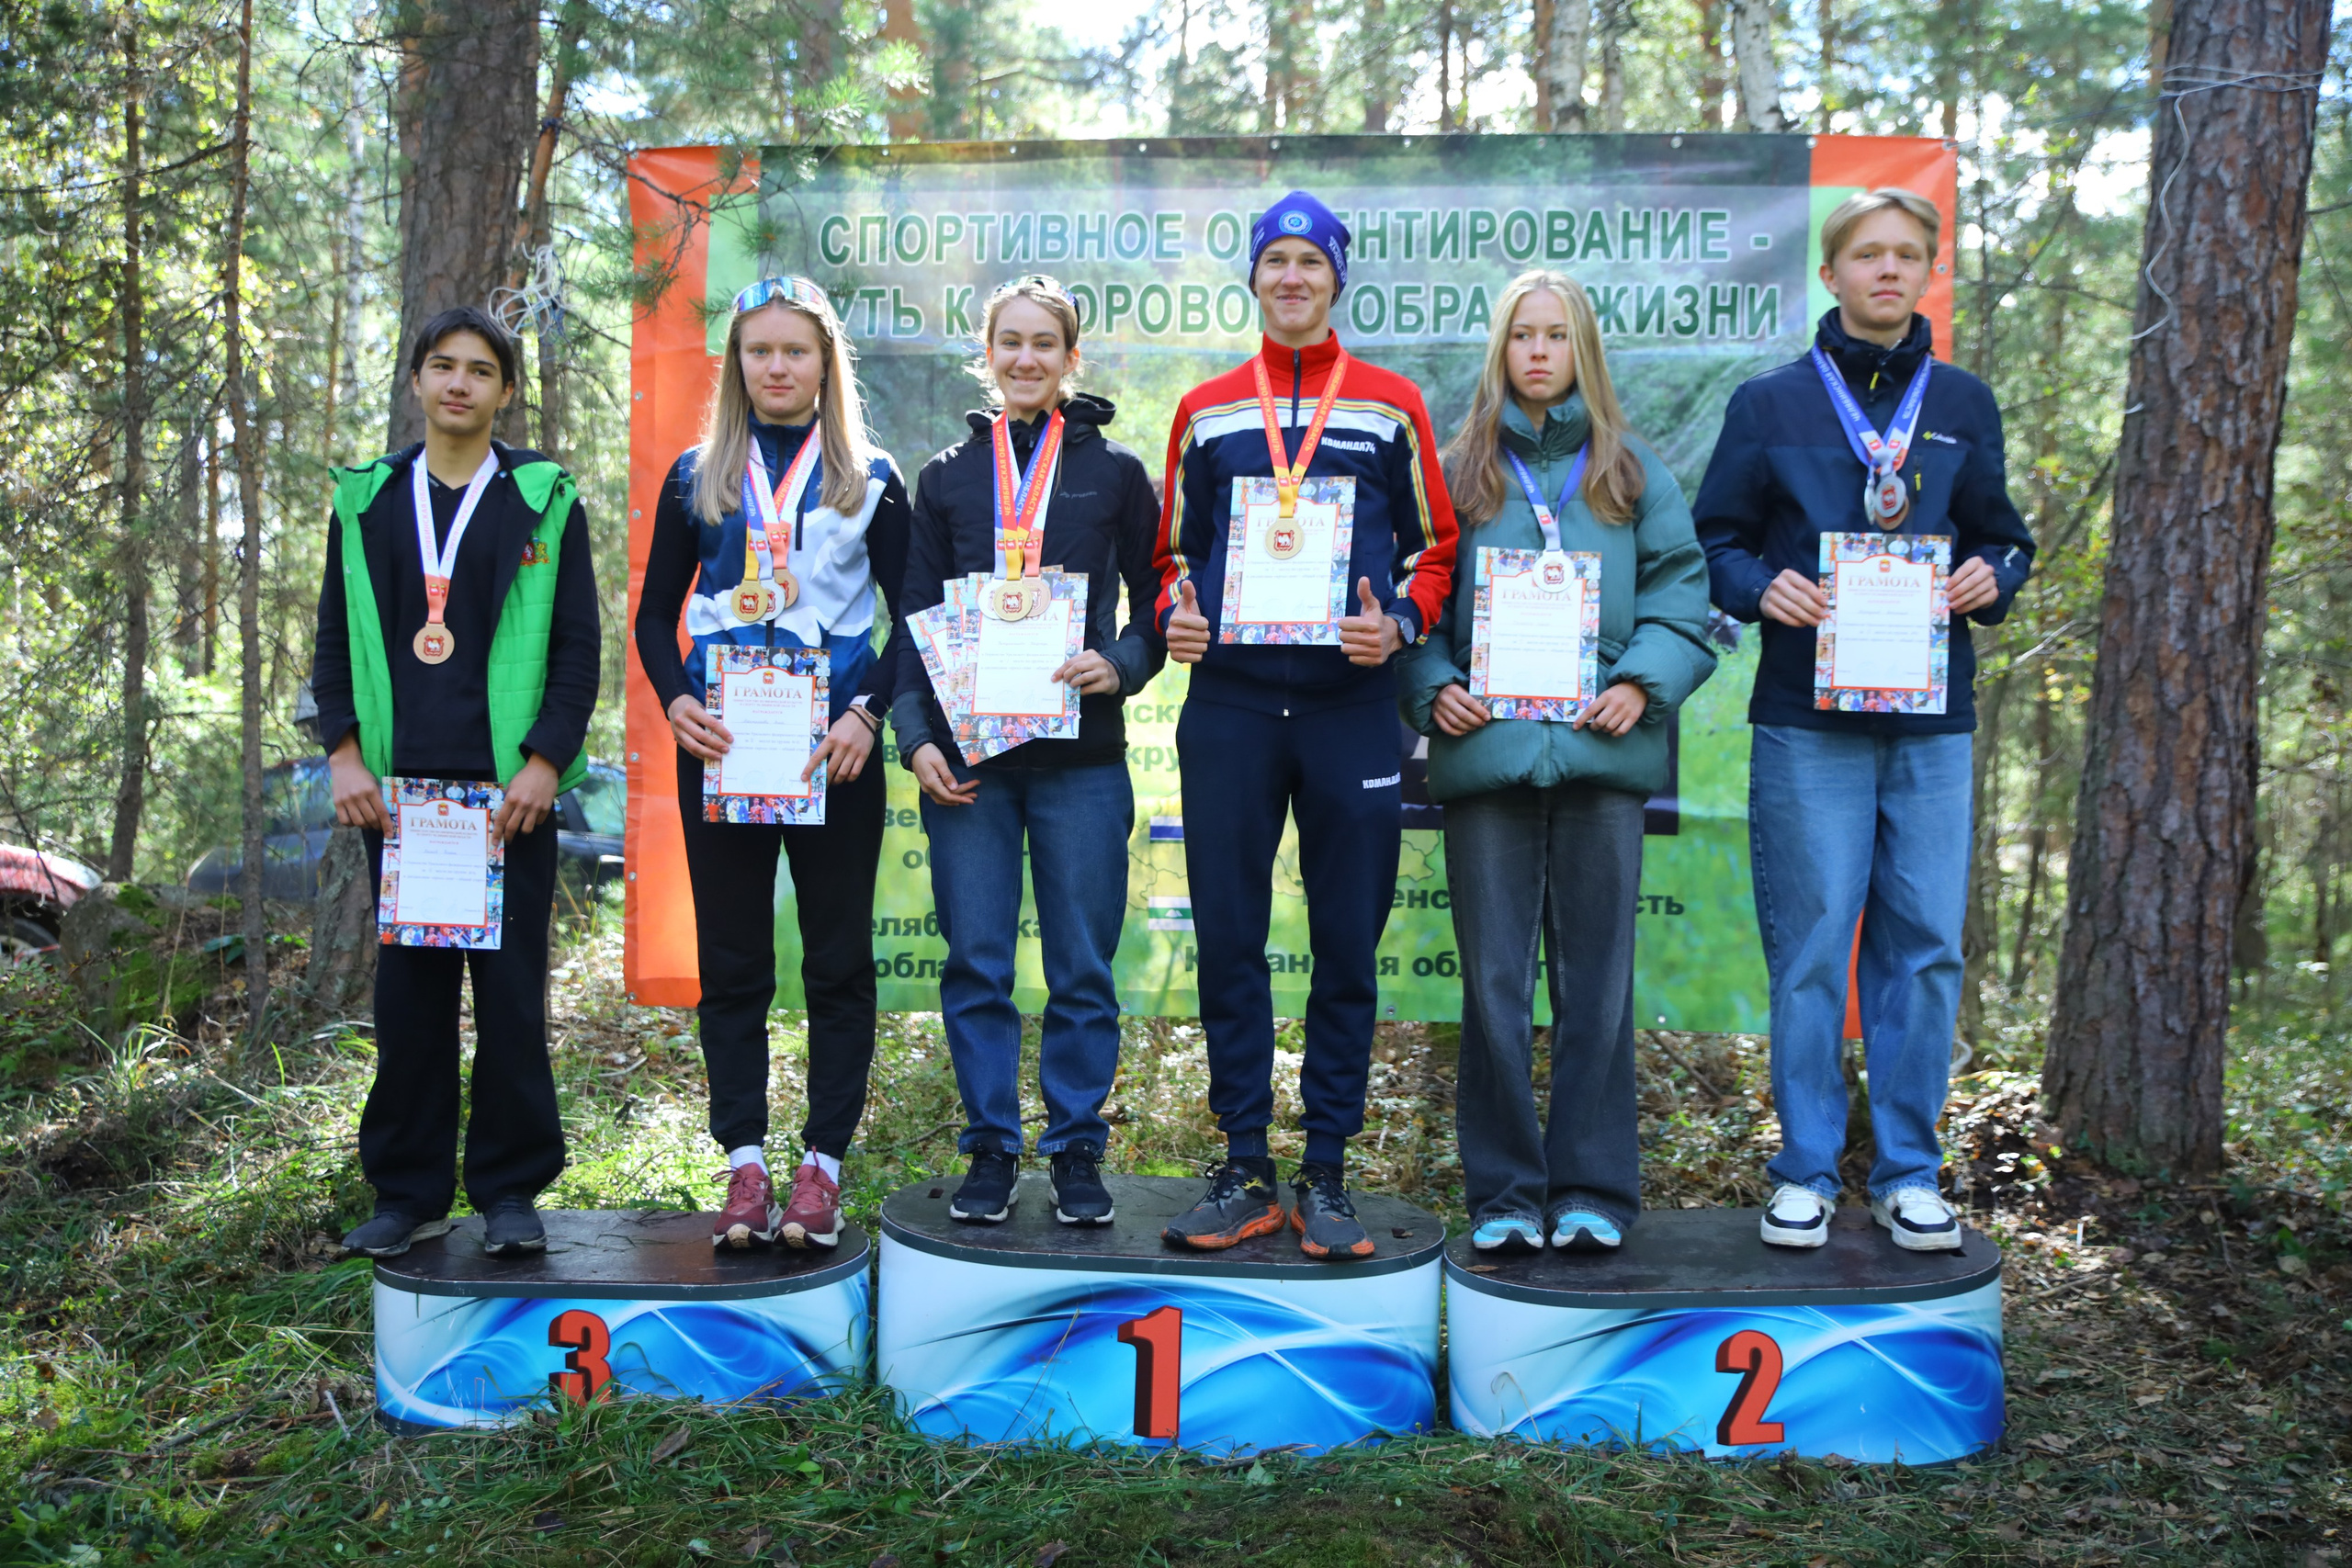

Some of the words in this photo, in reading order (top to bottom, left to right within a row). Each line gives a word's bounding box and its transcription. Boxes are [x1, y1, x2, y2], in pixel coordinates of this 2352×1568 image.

[820, 212, 1184, 266] СПОРТИВНОЕ
[1206, 209, 1731, 264] ОНТИРОВАНИЕ
[829, 288, 924, 337] УТЬ
[1351, 283, 1492, 334] ОБРА
[1585, 285, 1780, 338] ЖИЗНИ
[1255, 363, 1267, 396] ОБЛАСТЬ
[995, 424, 1004, 457] ОБЛАСТЬ
[1261, 397, 1280, 453] ЧЕЛЯБИНСКАЯ
[1305, 415, 1324, 452] ОБЛАСТЬ
[1038, 424, 1059, 479] ЧЕЛЯБИНСКАЯ
[1321, 436, 1376, 454] КОМАНДА74
[999, 459, 1010, 515] ЧЕЛЯБИНСКАЯ
[1026, 479, 1043, 515] ОБЛАСТЬ
[420, 503, 433, 560] ЧЕЛЯБИНСКАЯ
[1256, 516, 1325, 528] ГРОТА
[445, 525, 462, 561] ОБЛАСТЬ
[1847, 576, 1921, 588] ГРАМОТА
[733, 687, 802, 699] ГРАМОТА
[410, 817, 478, 830] ГРАМОТА
[548, 1309, 612, 1407] 3
[1118, 1305, 1182, 1438] 1
[1714, 1329, 1784, 1446] 2
